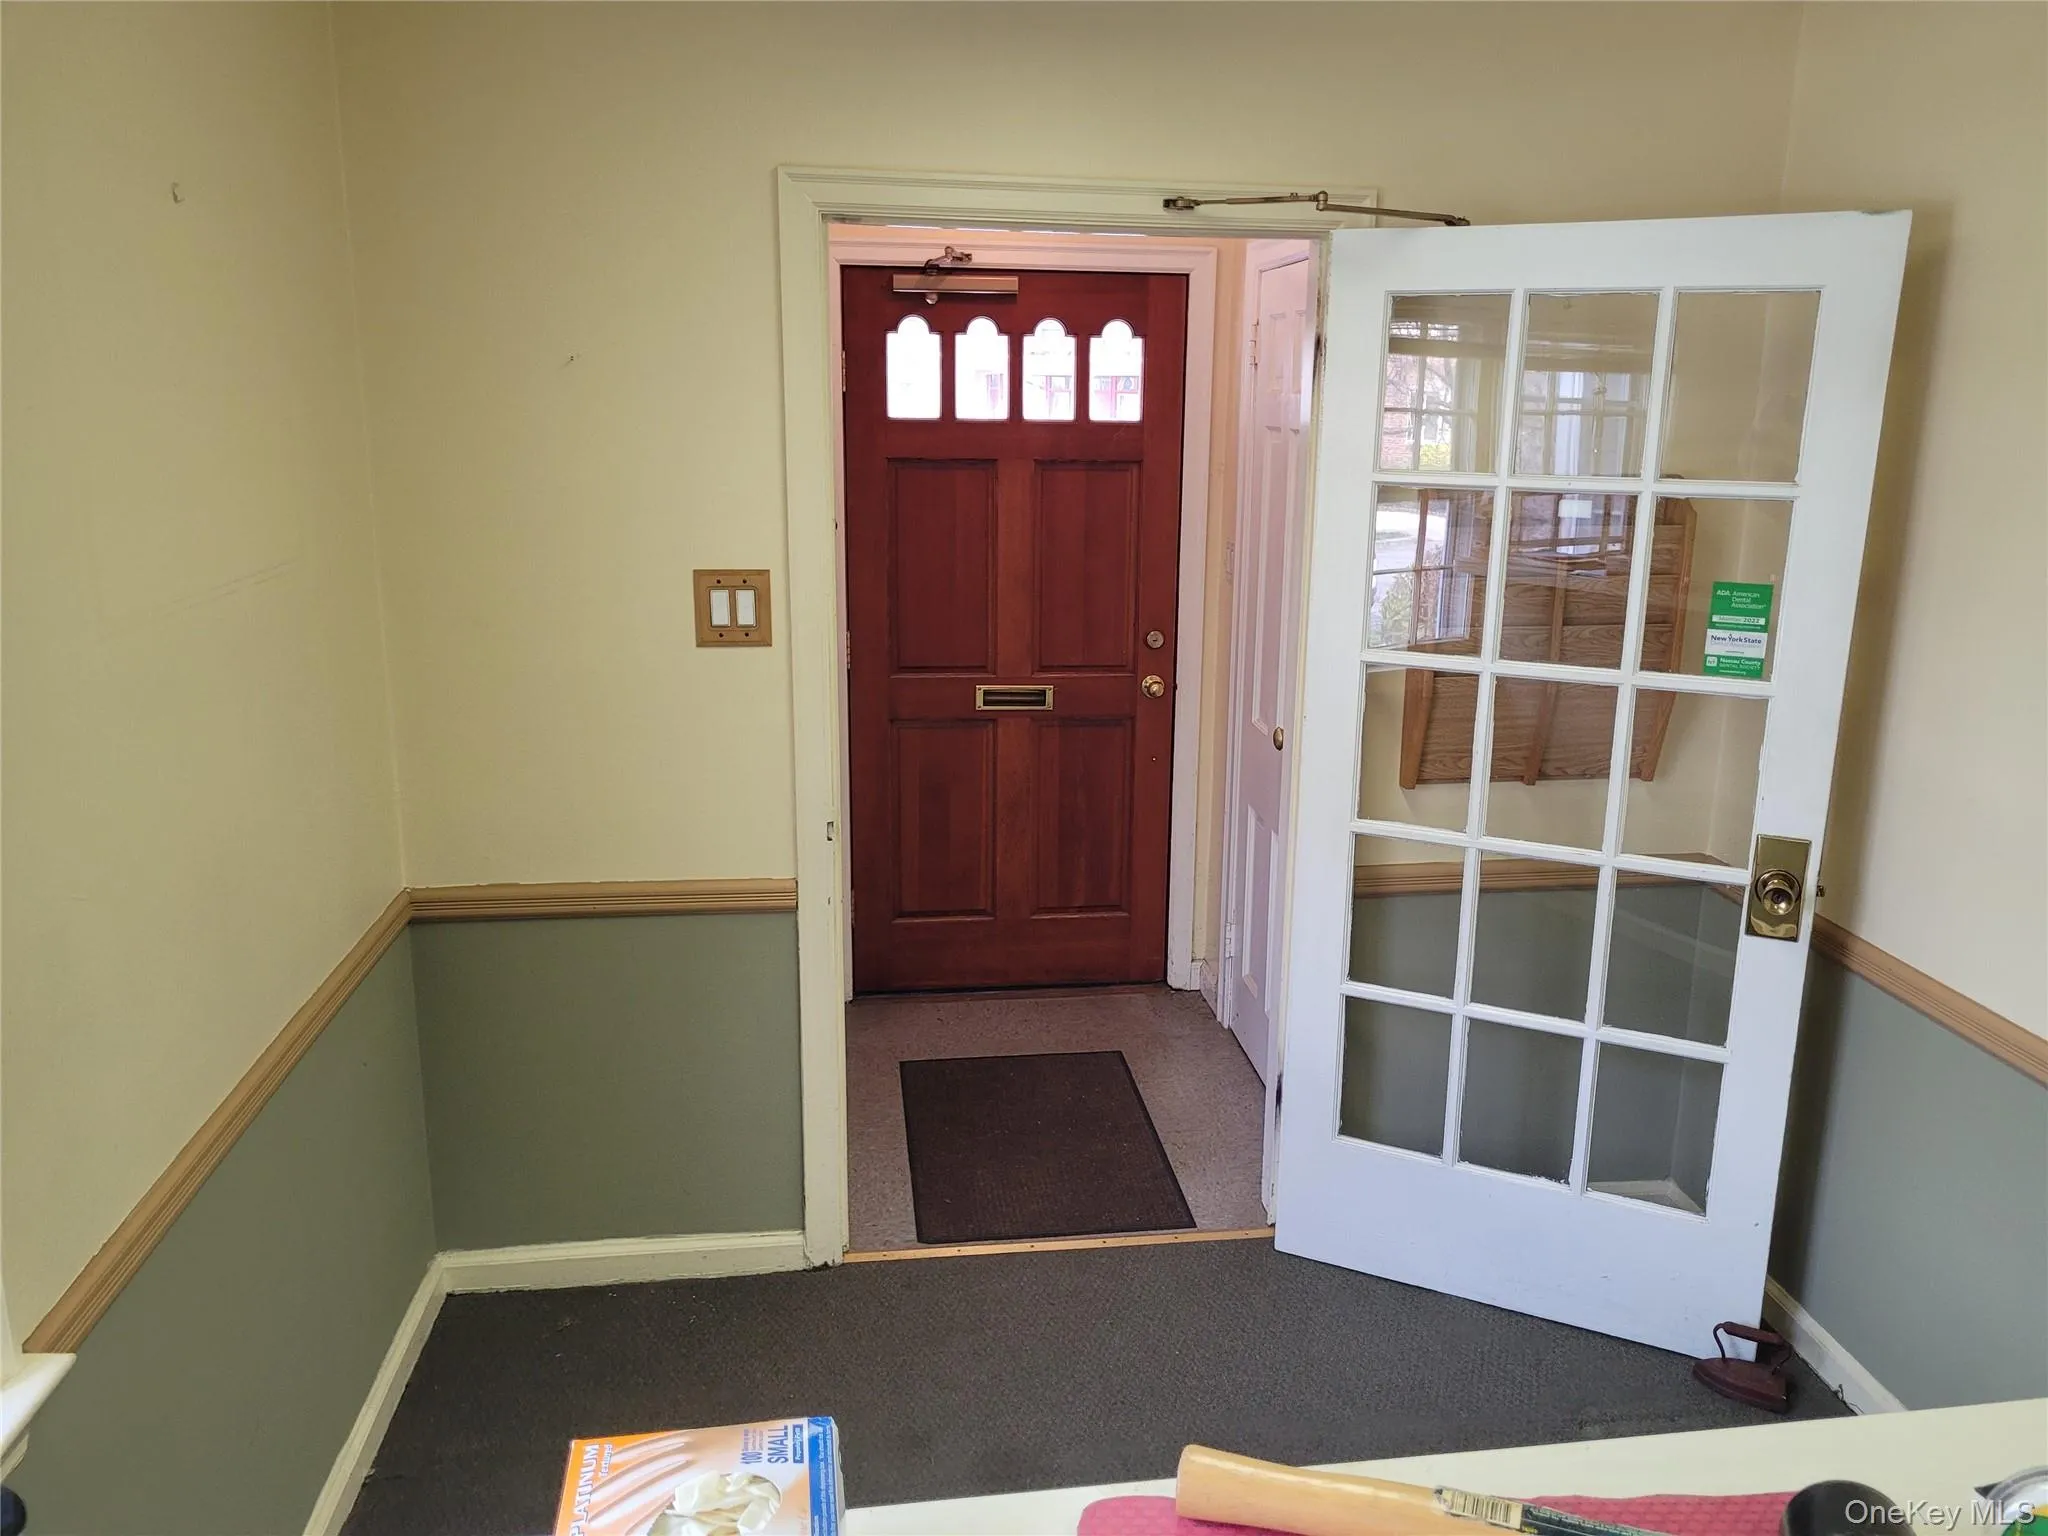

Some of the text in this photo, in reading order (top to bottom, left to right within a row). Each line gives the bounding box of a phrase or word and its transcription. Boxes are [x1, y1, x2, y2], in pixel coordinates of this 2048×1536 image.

[1741, 659, 1761, 667] County
[767, 1425, 789, 1464] SMALL
[740, 1451, 763, 1465] 100
[570, 1444, 600, 1536] PLATINUM
